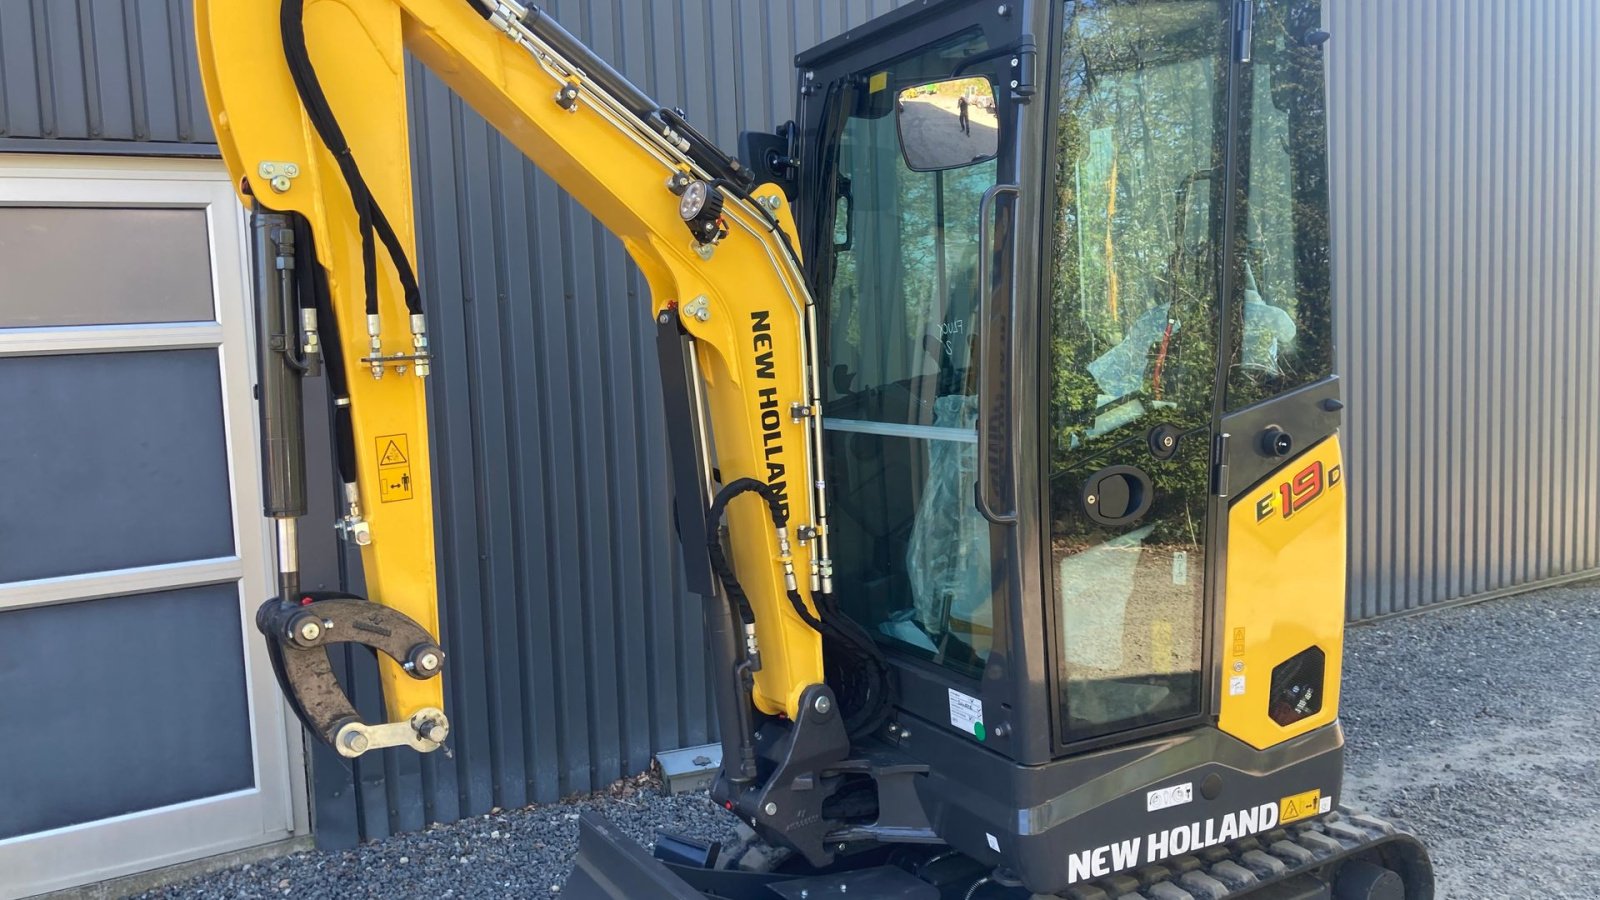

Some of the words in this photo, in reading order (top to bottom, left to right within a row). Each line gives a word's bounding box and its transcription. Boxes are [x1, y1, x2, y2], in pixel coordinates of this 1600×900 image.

[751, 311, 775, 379] NEW
[1068, 837, 1141, 884] NEW
[1147, 801, 1279, 863] HOLLAND
